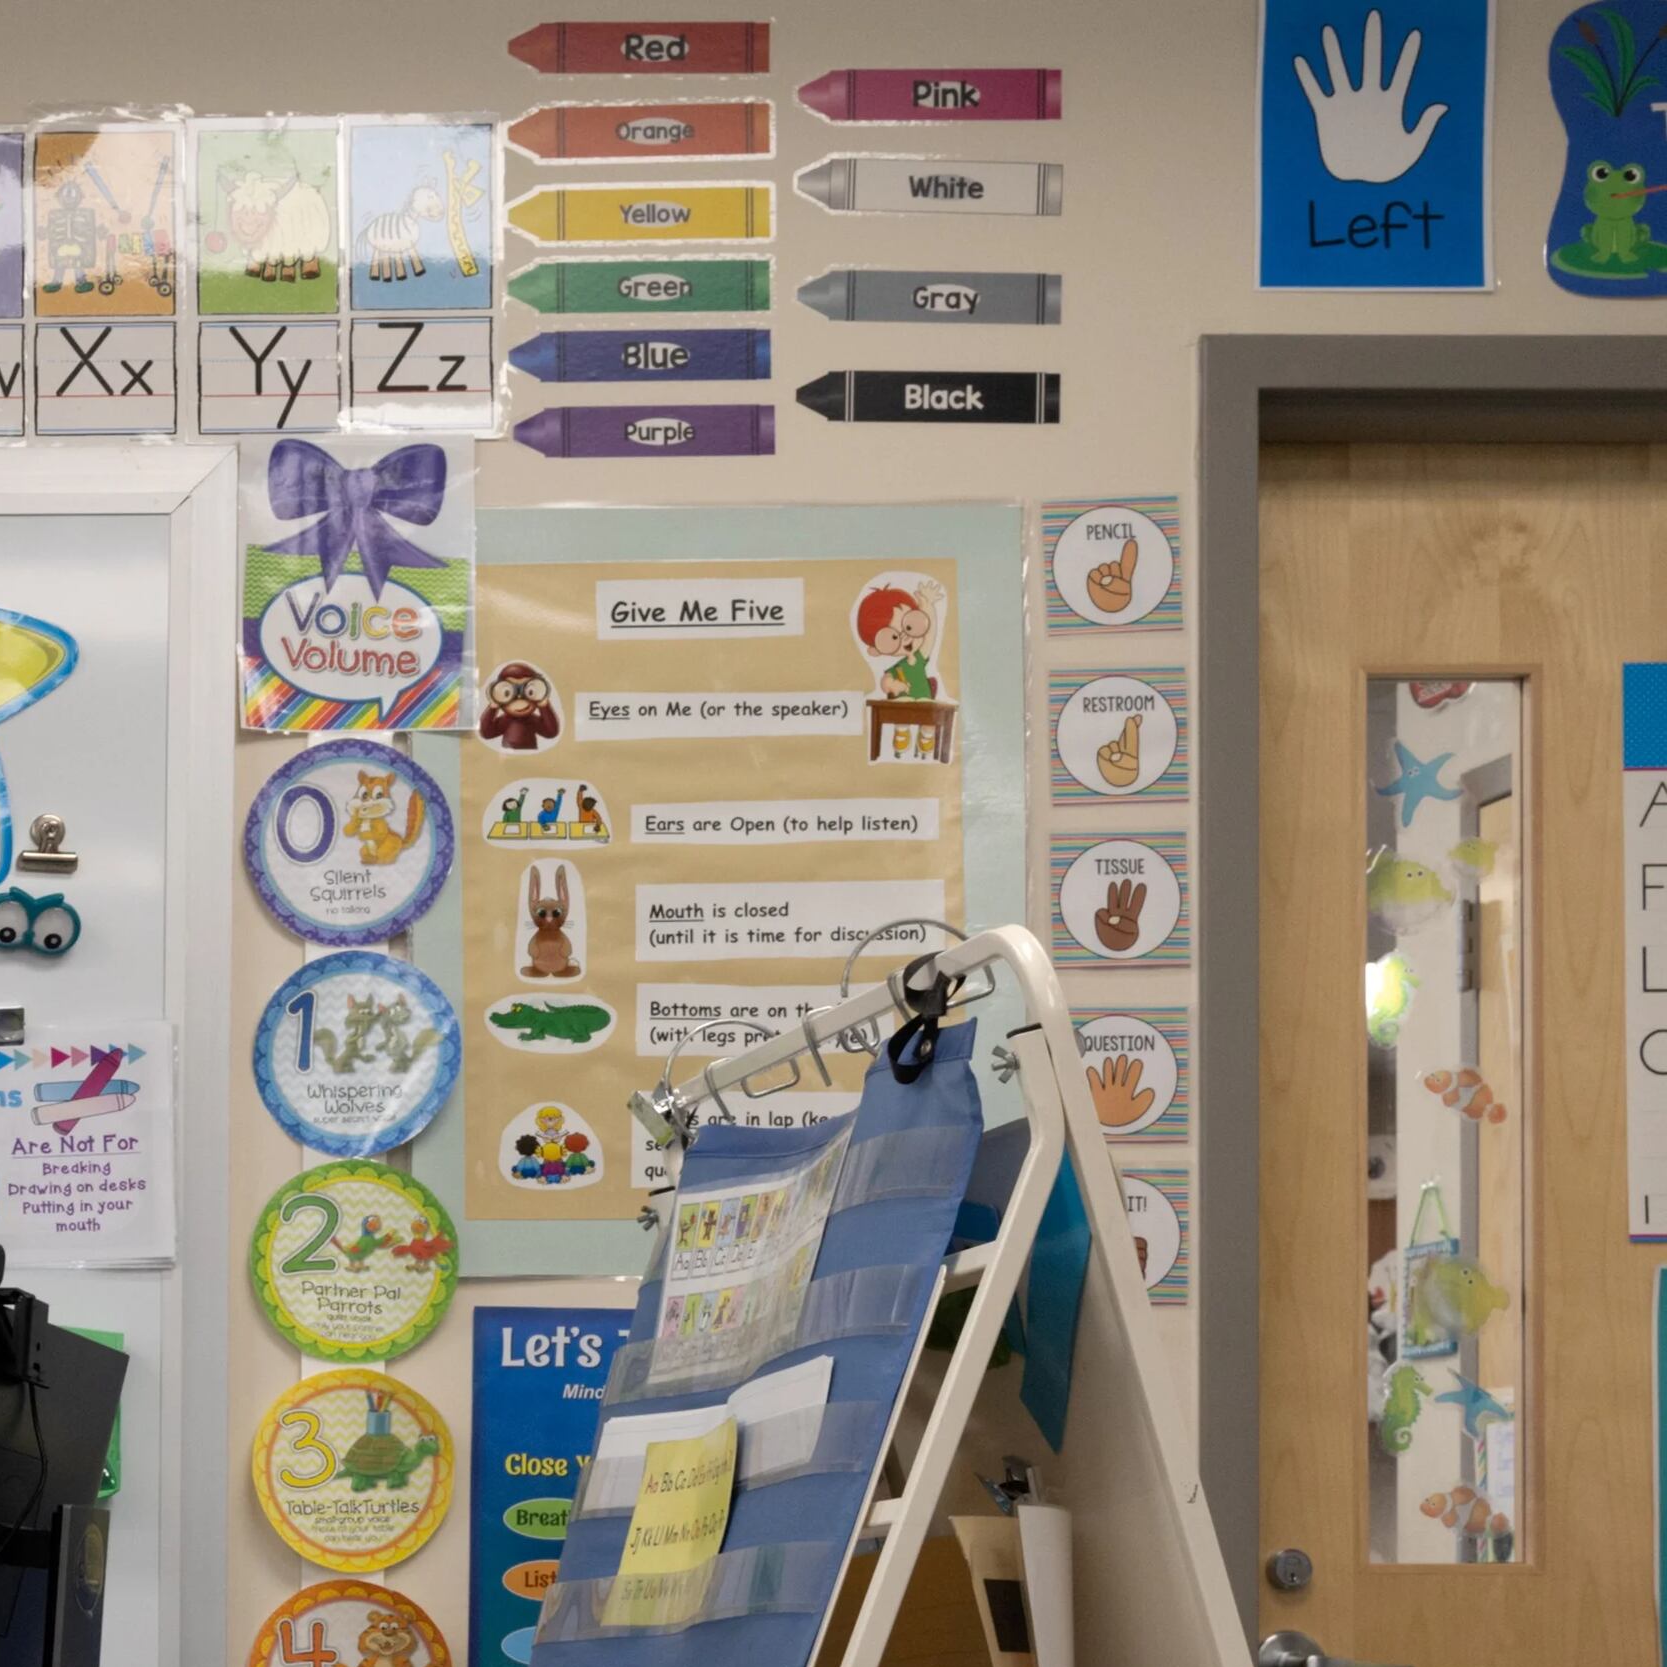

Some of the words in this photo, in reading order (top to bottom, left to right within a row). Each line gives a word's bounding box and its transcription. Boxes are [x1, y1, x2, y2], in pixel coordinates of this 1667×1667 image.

[624, 35, 686, 61] Red
[913, 81, 980, 109] Pink
[615, 122, 695, 143] Orange
[909, 175, 984, 199] White
[619, 203, 690, 224] Yellow
[1308, 201, 1444, 249] Left
[617, 277, 693, 298] Green
[913, 287, 979, 314] Gray
[57, 325, 153, 396] Xx
[379, 321, 466, 392] Zz
[622, 343, 689, 368] Blue
[229, 324, 311, 427] Yy
[904, 385, 984, 411] Black
[623, 422, 696, 448] Purple
[1086, 522, 1136, 541] PENCIL
[283, 591, 423, 639] Voice
[611, 601, 666, 623] Give
[680, 601, 717, 622] Me
[731, 600, 784, 622] Five
[281, 637, 420, 676] Volume
[590, 701, 630, 720] Eyes
[639, 704, 659, 717] on
[667, 701, 692, 717] Me
[700, 701, 726, 719] (or
[734, 701, 763, 717] the
[772, 699, 848, 720] speaker)
[1083, 694, 1155, 714] RESTROOM
[275, 785, 336, 864] 0
[324, 870, 371, 886] Silent
[1095, 858, 1145, 876] TISSUE
[310, 884, 386, 902] Squirrels
[287, 990, 316, 1073] 1
[1083, 1033, 1155, 1054] QUESTION
[308, 1084, 402, 1101] Whispering
[324, 1100, 385, 1115] Wolves
[11, 1137, 51, 1155] Are
[60, 1136, 95, 1152] Not
[103, 1135, 139, 1151] For
[280, 1194, 340, 1276] 2
[301, 1281, 369, 1298] Partner
[374, 1286, 401, 1301] Pal
[317, 1298, 382, 1315] Parrots
[279, 1410, 338, 1489] 3
[286, 1500, 360, 1515] Table-Talk
[363, 1500, 420, 1515] Turtles
